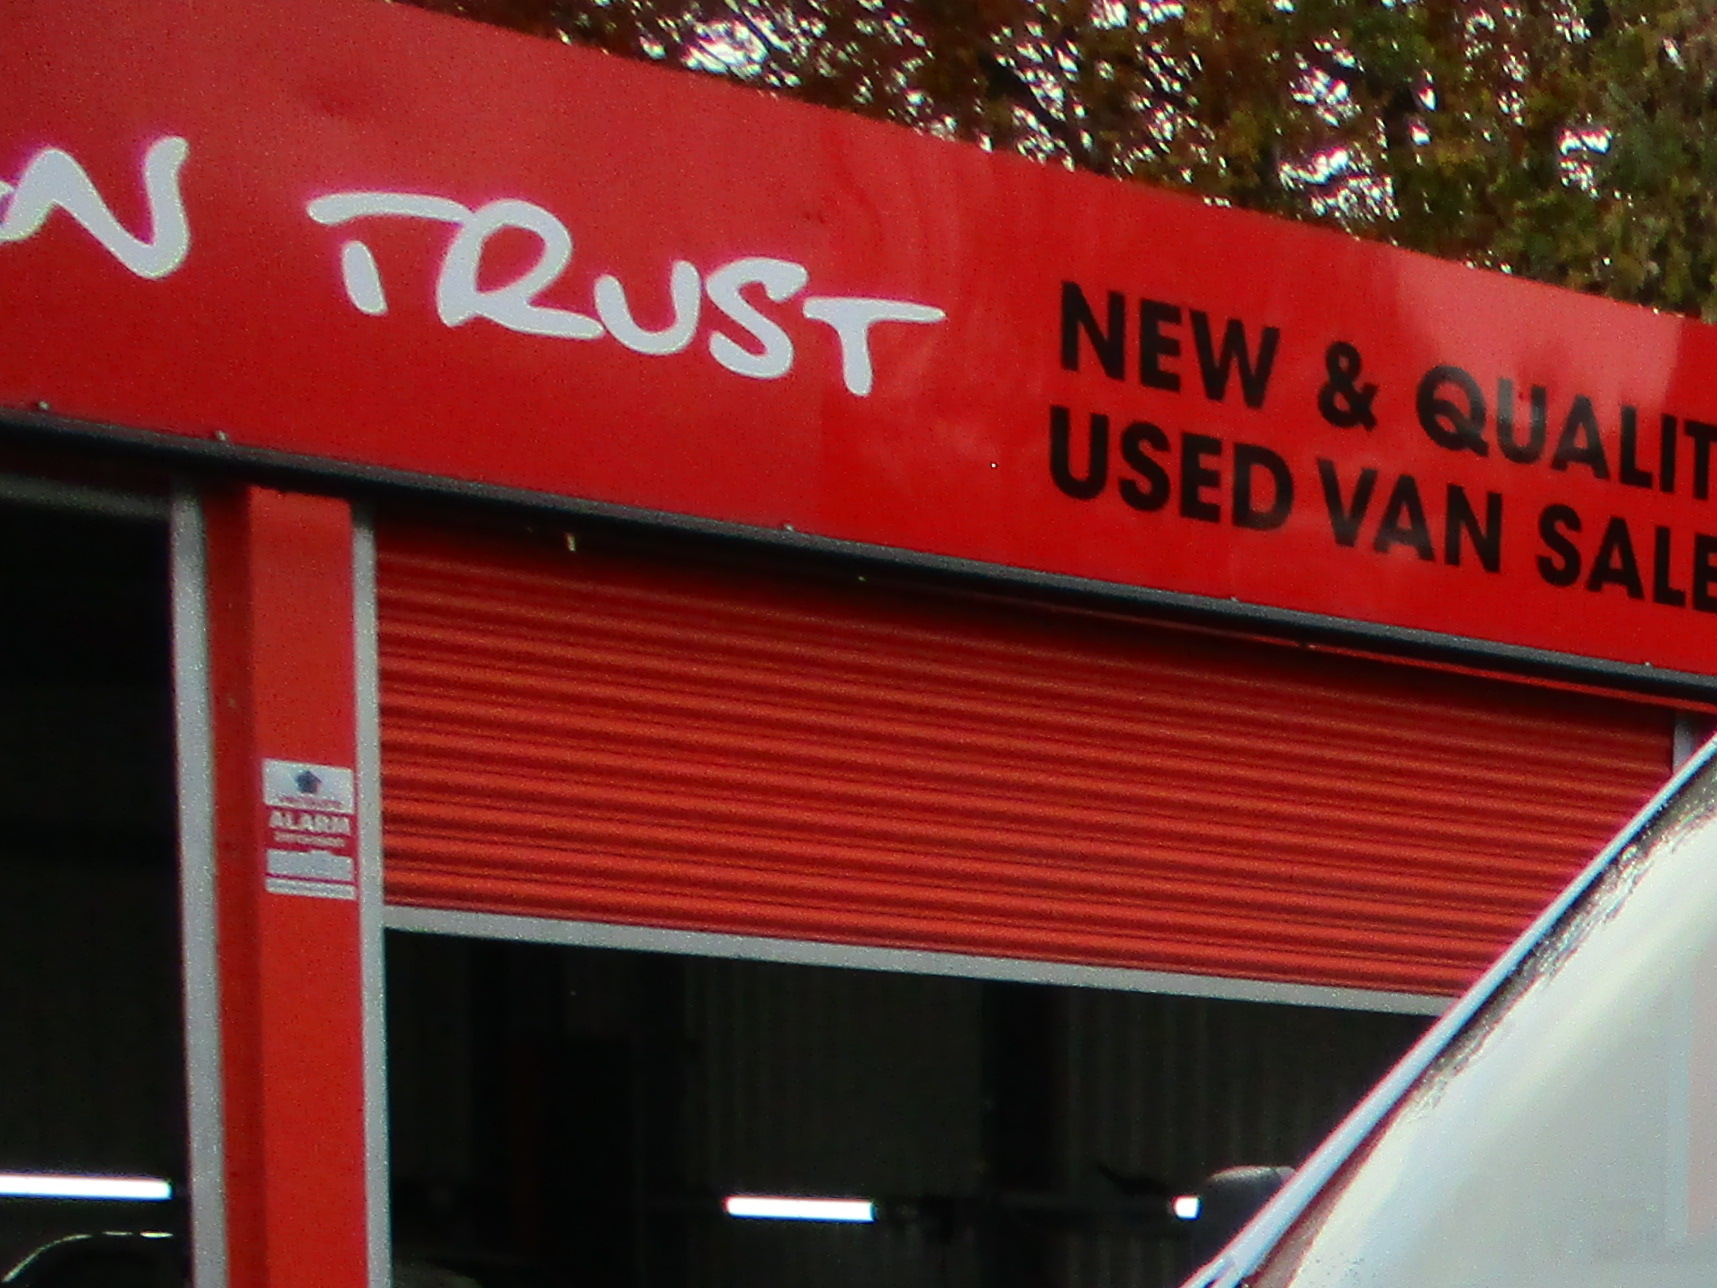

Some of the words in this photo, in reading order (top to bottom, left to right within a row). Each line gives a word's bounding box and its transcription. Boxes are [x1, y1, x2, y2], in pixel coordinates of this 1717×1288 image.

[306, 188, 946, 398] TRUST
[1058, 280, 1280, 408] NEW
[1317, 341, 1379, 431] &
[1048, 405, 1295, 531] USED
[1317, 458, 1504, 574] VAN
[268, 810, 351, 836] ALARM
